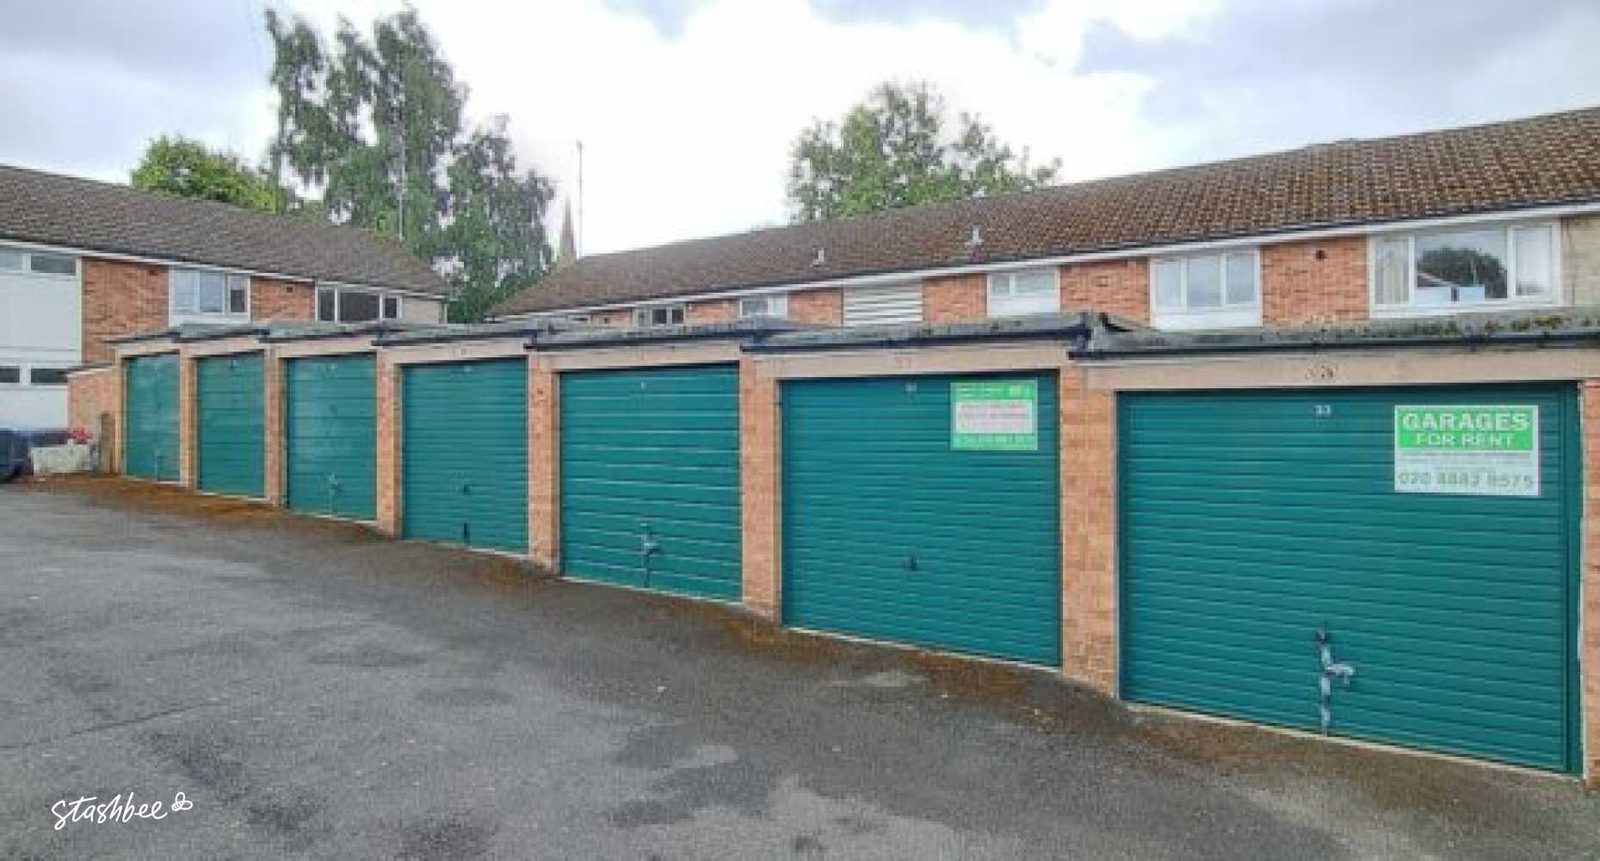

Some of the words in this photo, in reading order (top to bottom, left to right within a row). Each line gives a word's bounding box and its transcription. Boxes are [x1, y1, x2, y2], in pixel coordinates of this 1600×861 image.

[1402, 411, 1530, 431] GARAGES
[1415, 432, 1454, 447] FOR
[1461, 432, 1514, 448] RENT
[1399, 471, 1432, 485] 020
